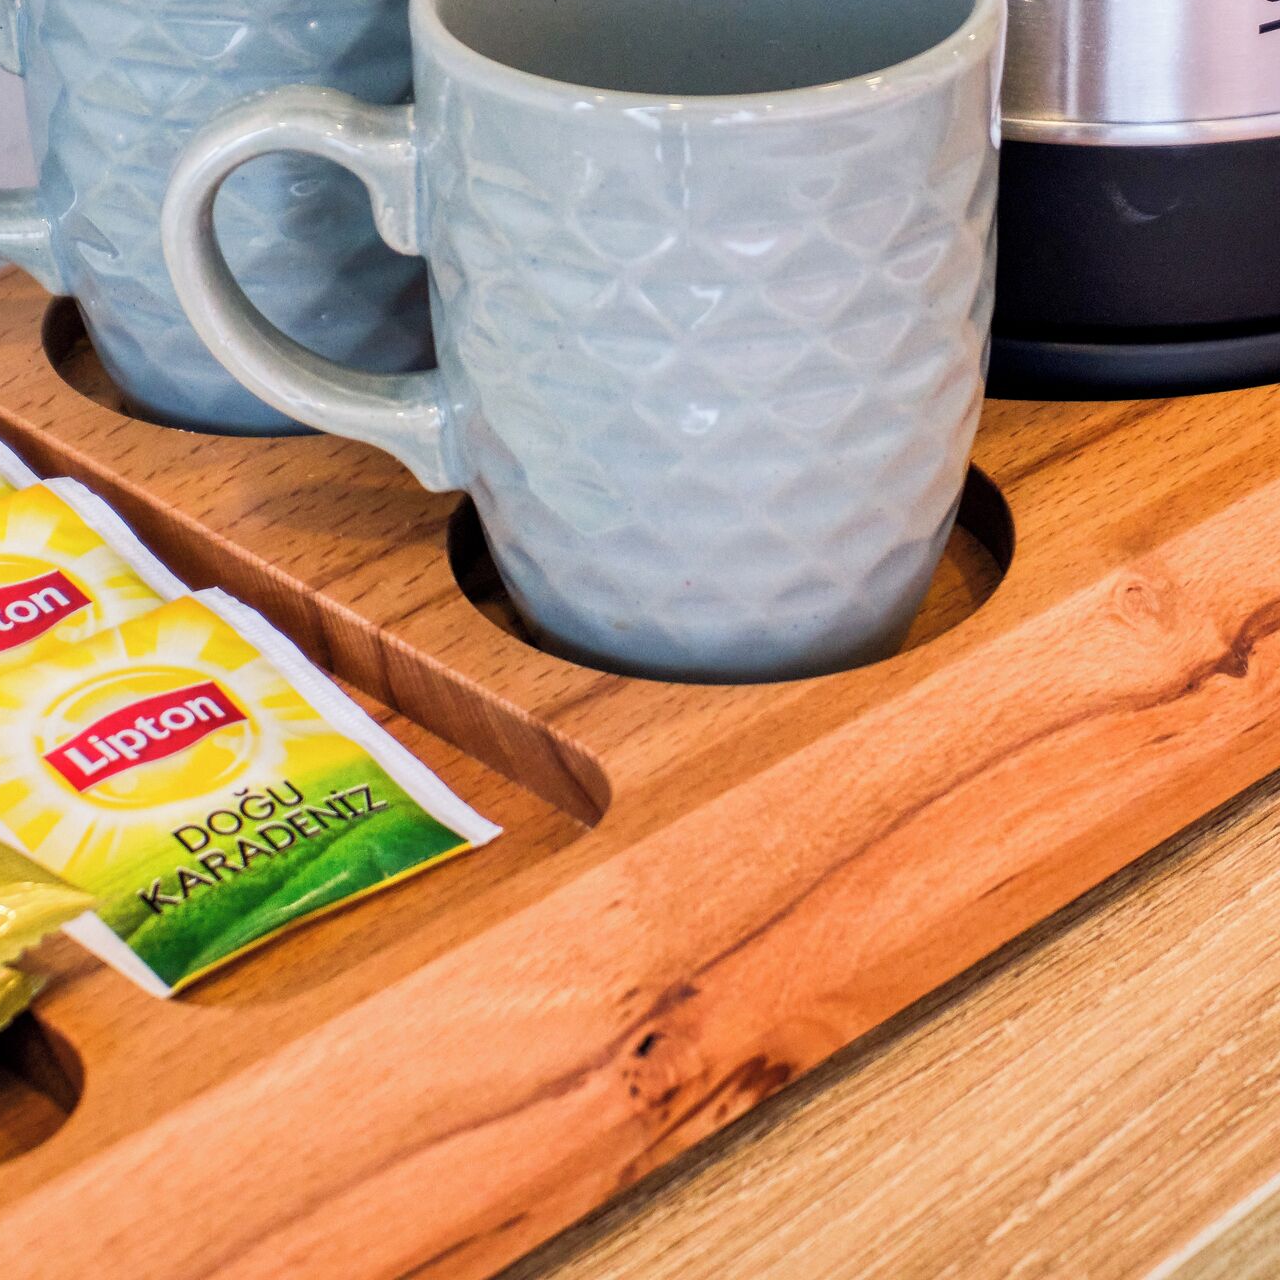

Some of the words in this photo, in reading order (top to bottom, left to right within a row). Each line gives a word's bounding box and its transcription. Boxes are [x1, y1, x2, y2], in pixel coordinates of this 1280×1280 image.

[63, 692, 227, 777] Lipton
[136, 782, 389, 915] KARADENİZ
[171, 778, 305, 855] DOĞU
